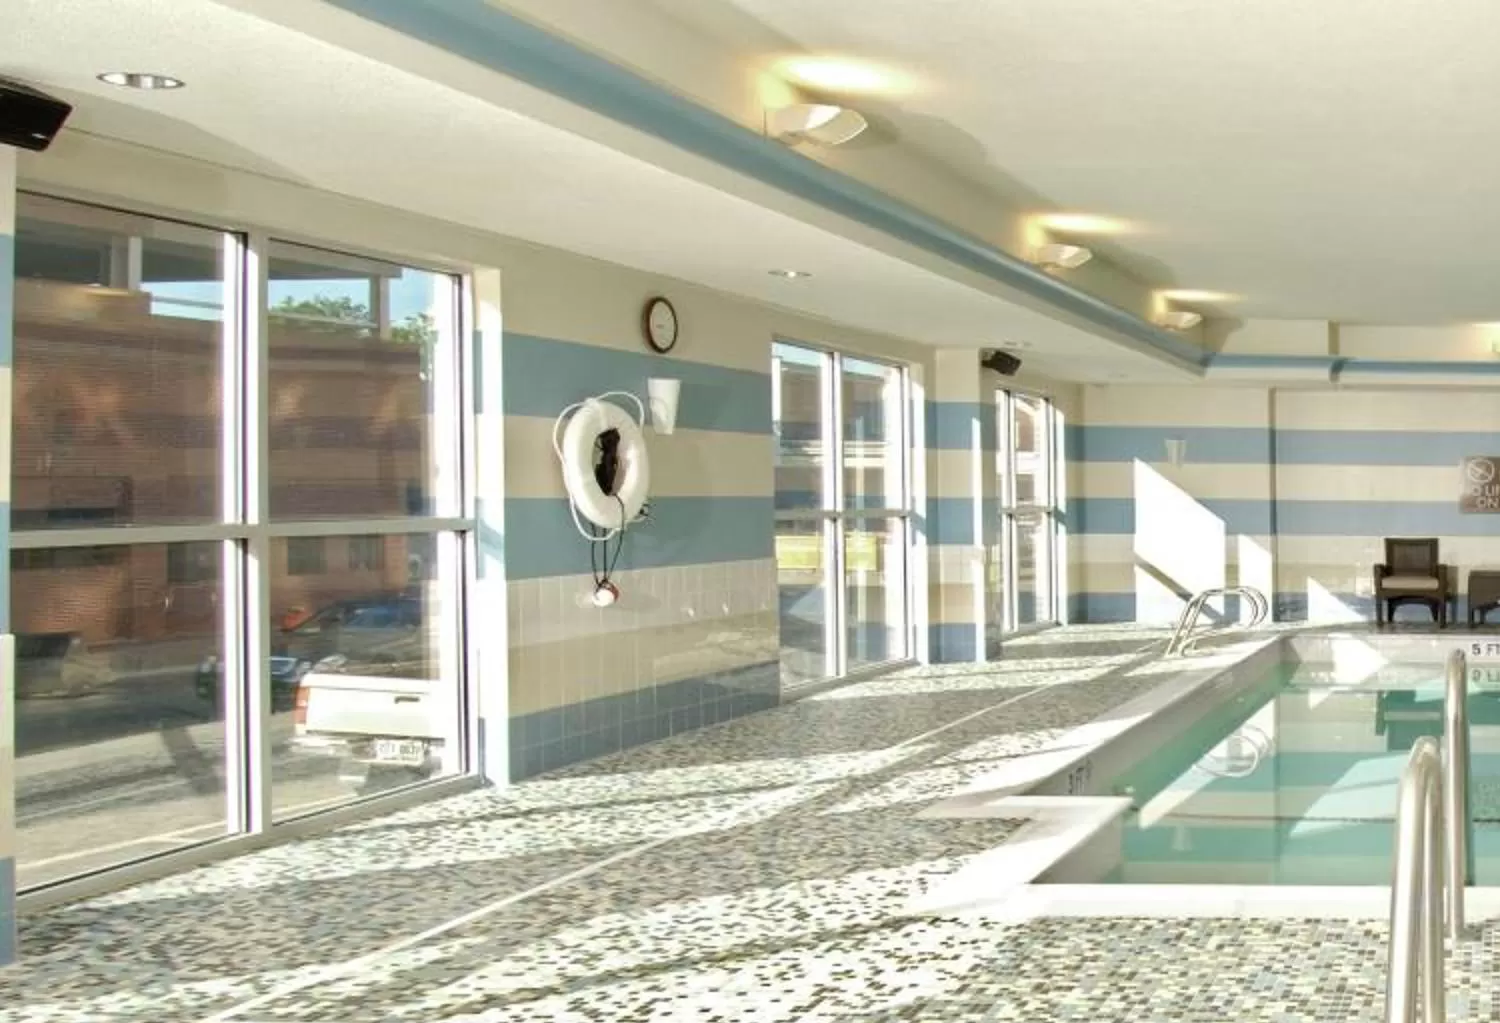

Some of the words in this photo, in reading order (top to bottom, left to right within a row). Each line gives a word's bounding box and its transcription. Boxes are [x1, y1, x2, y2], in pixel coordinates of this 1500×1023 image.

[1476, 498, 1499, 509] ON
[1472, 643, 1481, 655] 5
[1487, 643, 1500, 655] FT
